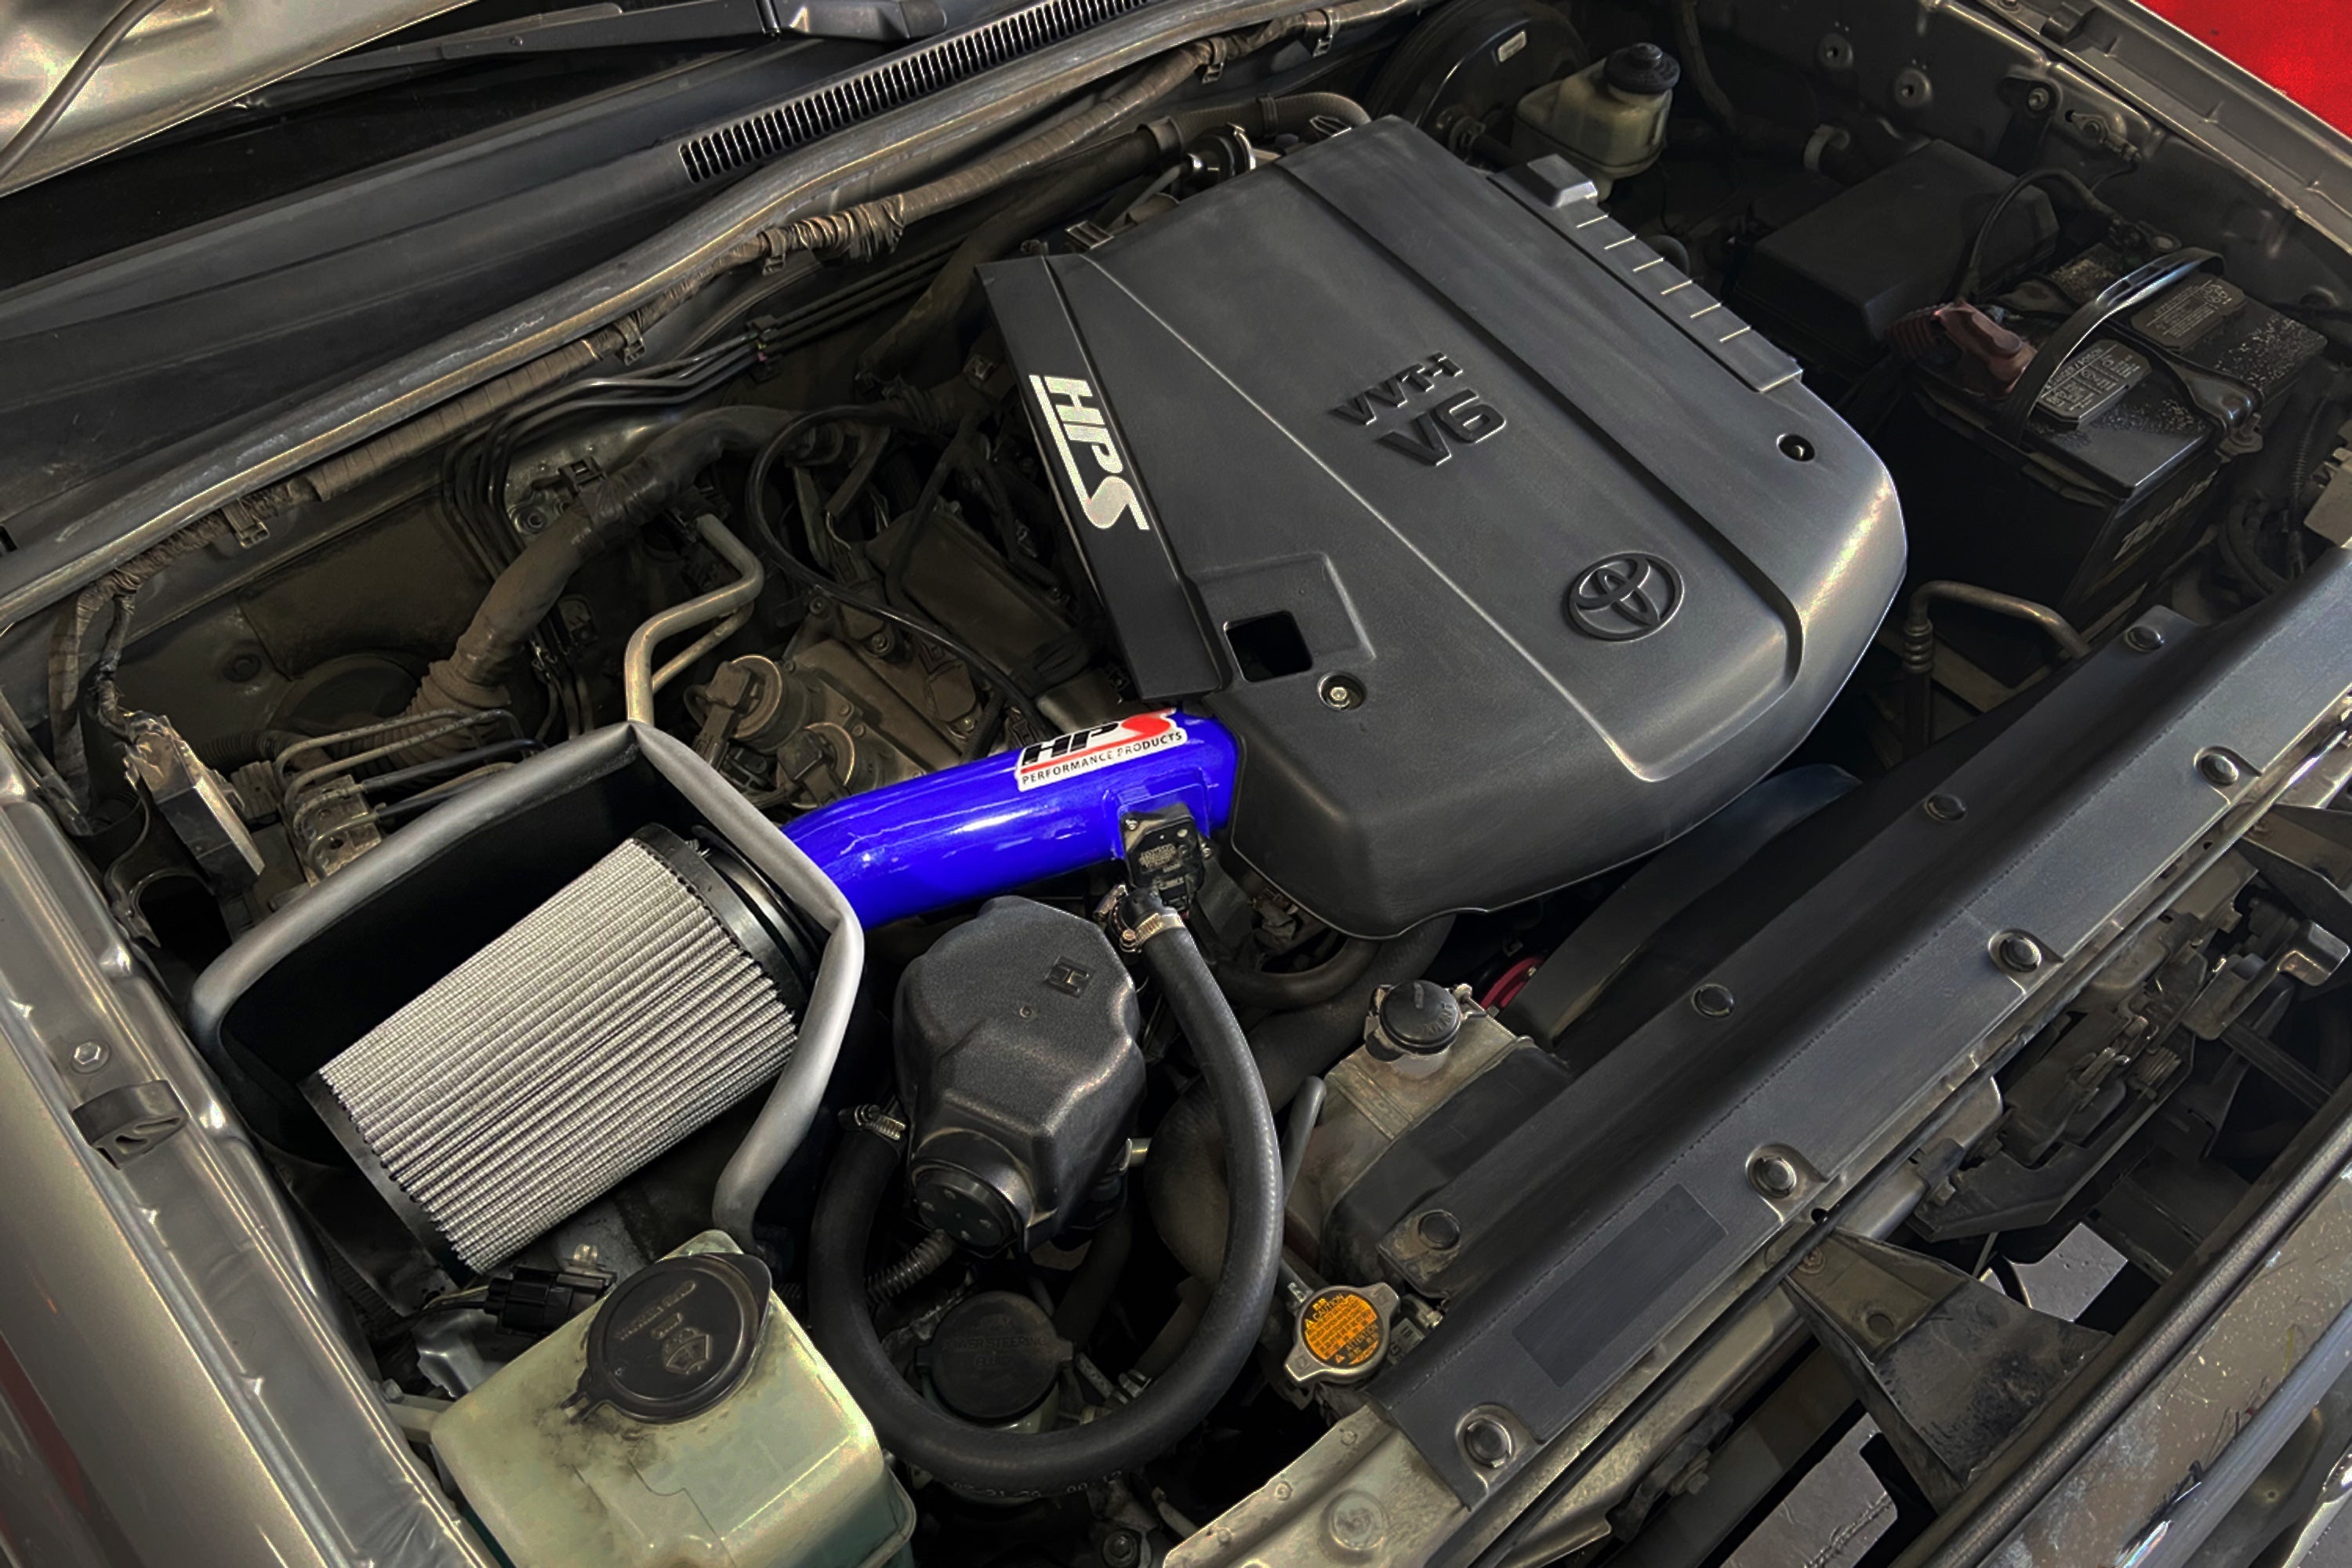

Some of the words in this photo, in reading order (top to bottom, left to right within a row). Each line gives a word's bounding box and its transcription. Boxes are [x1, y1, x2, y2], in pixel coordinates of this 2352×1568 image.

[1029, 375, 1149, 530] HPS
[1377, 388, 1506, 466] V6
[1021, 708, 1175, 774] HPS
[1022, 750, 1113, 785] PERFORMANCE
[1117, 731, 1182, 758] PRODUCTS
[1312, 1294, 1345, 1320] CAUTION
[986, 1335, 1047, 1348] STEERING
